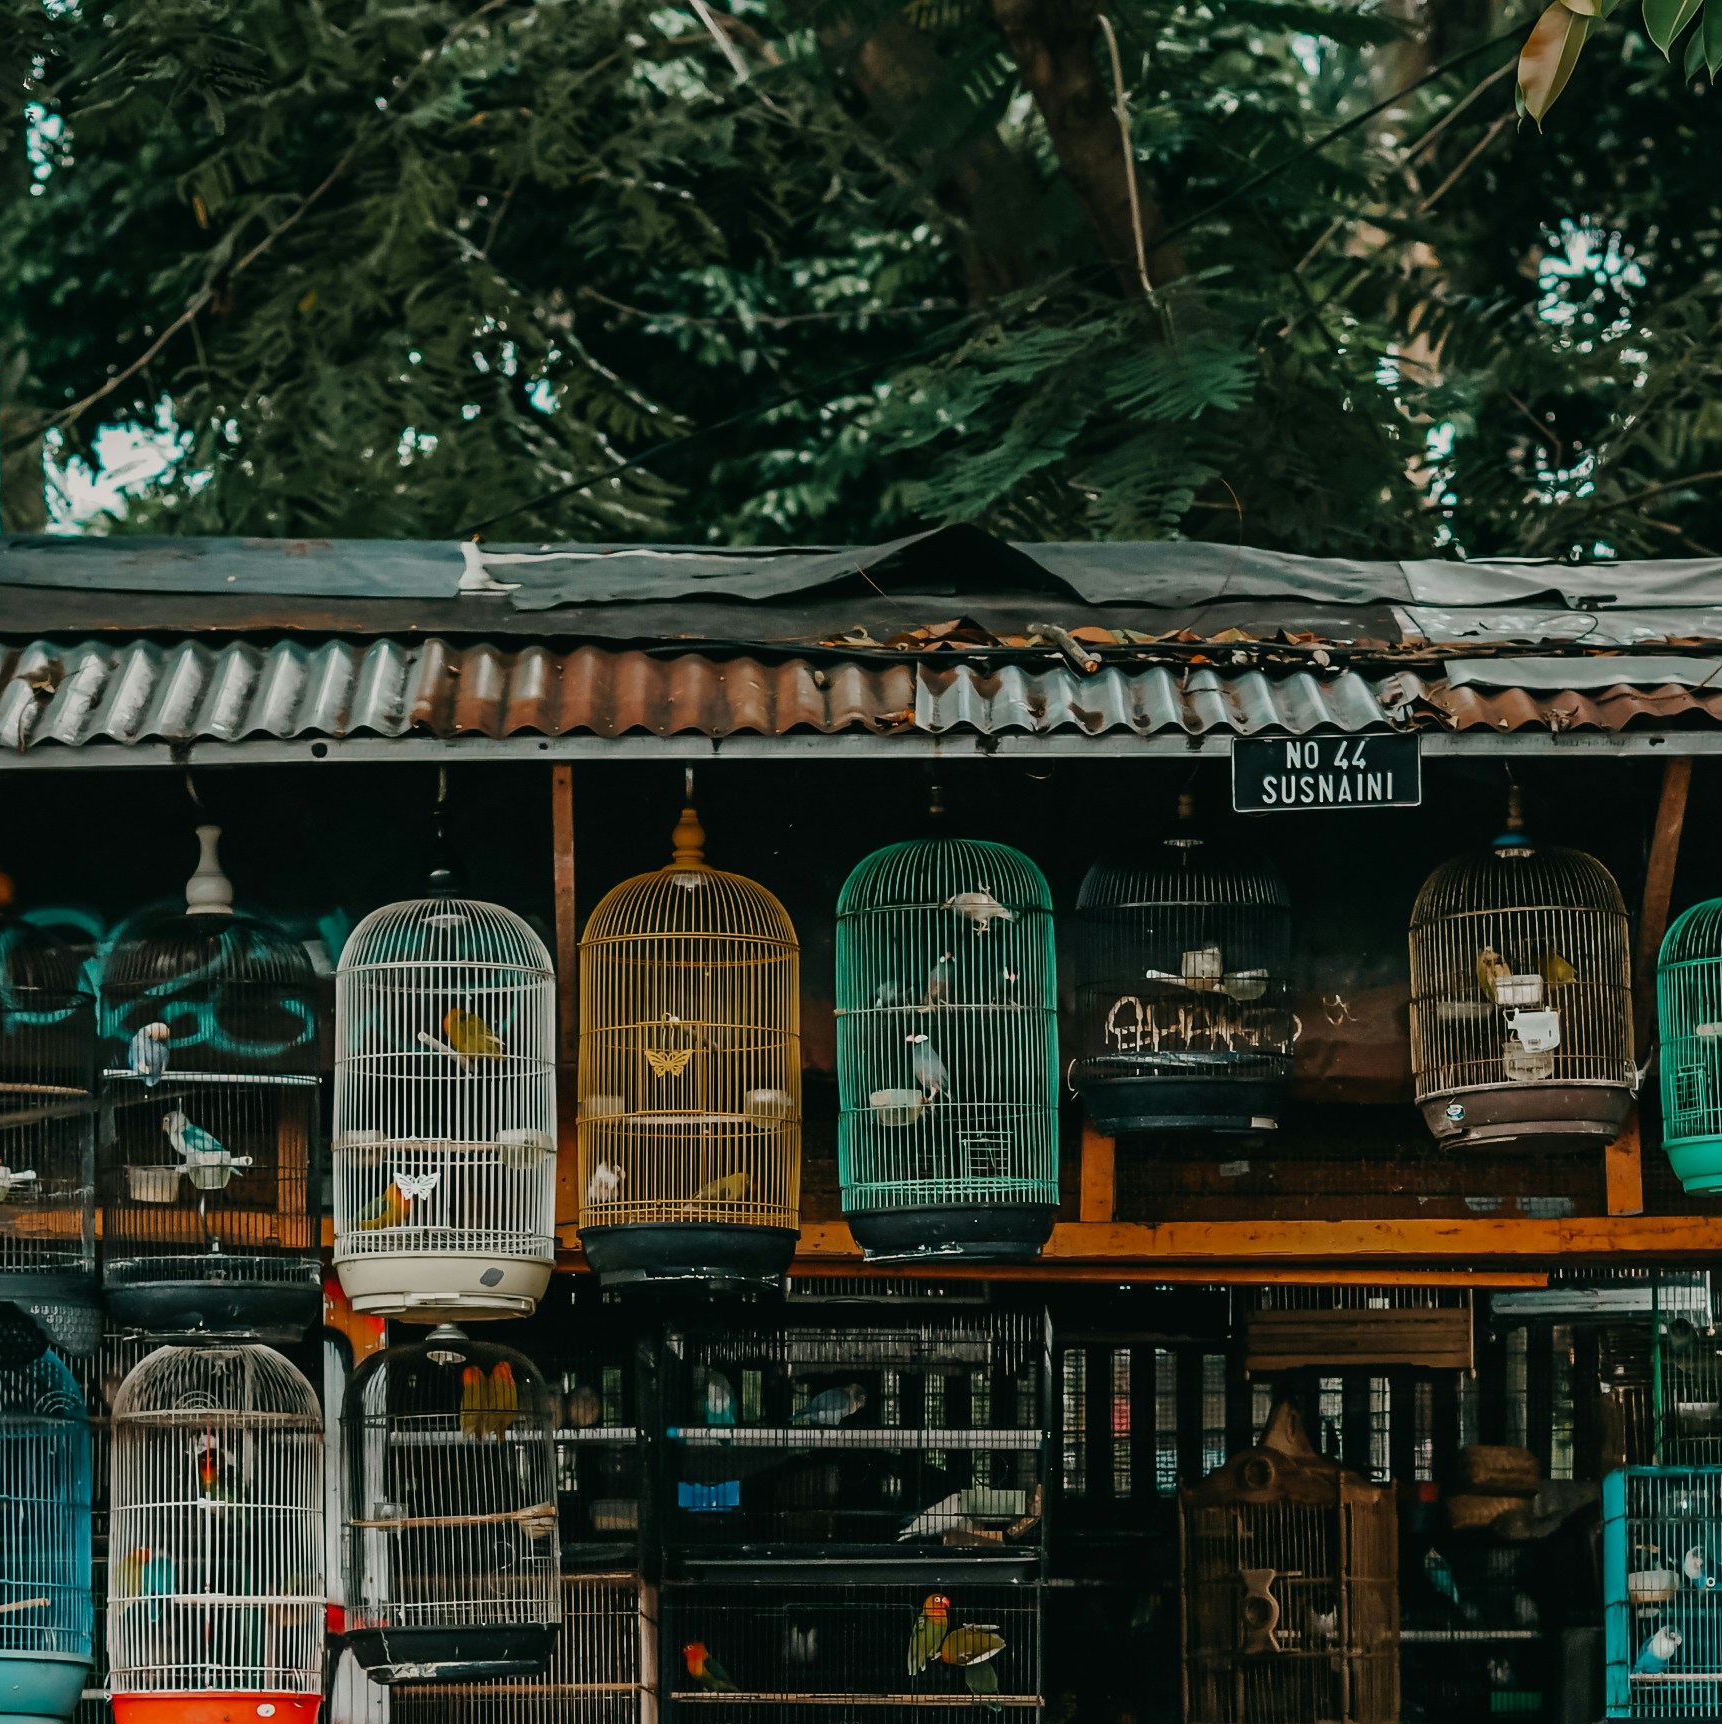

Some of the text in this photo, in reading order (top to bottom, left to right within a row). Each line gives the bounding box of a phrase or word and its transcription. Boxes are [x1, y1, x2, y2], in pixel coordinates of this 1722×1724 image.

[1286, 740, 1367, 770] NO 44
[1262, 772, 1394, 804] SUSNAINI
